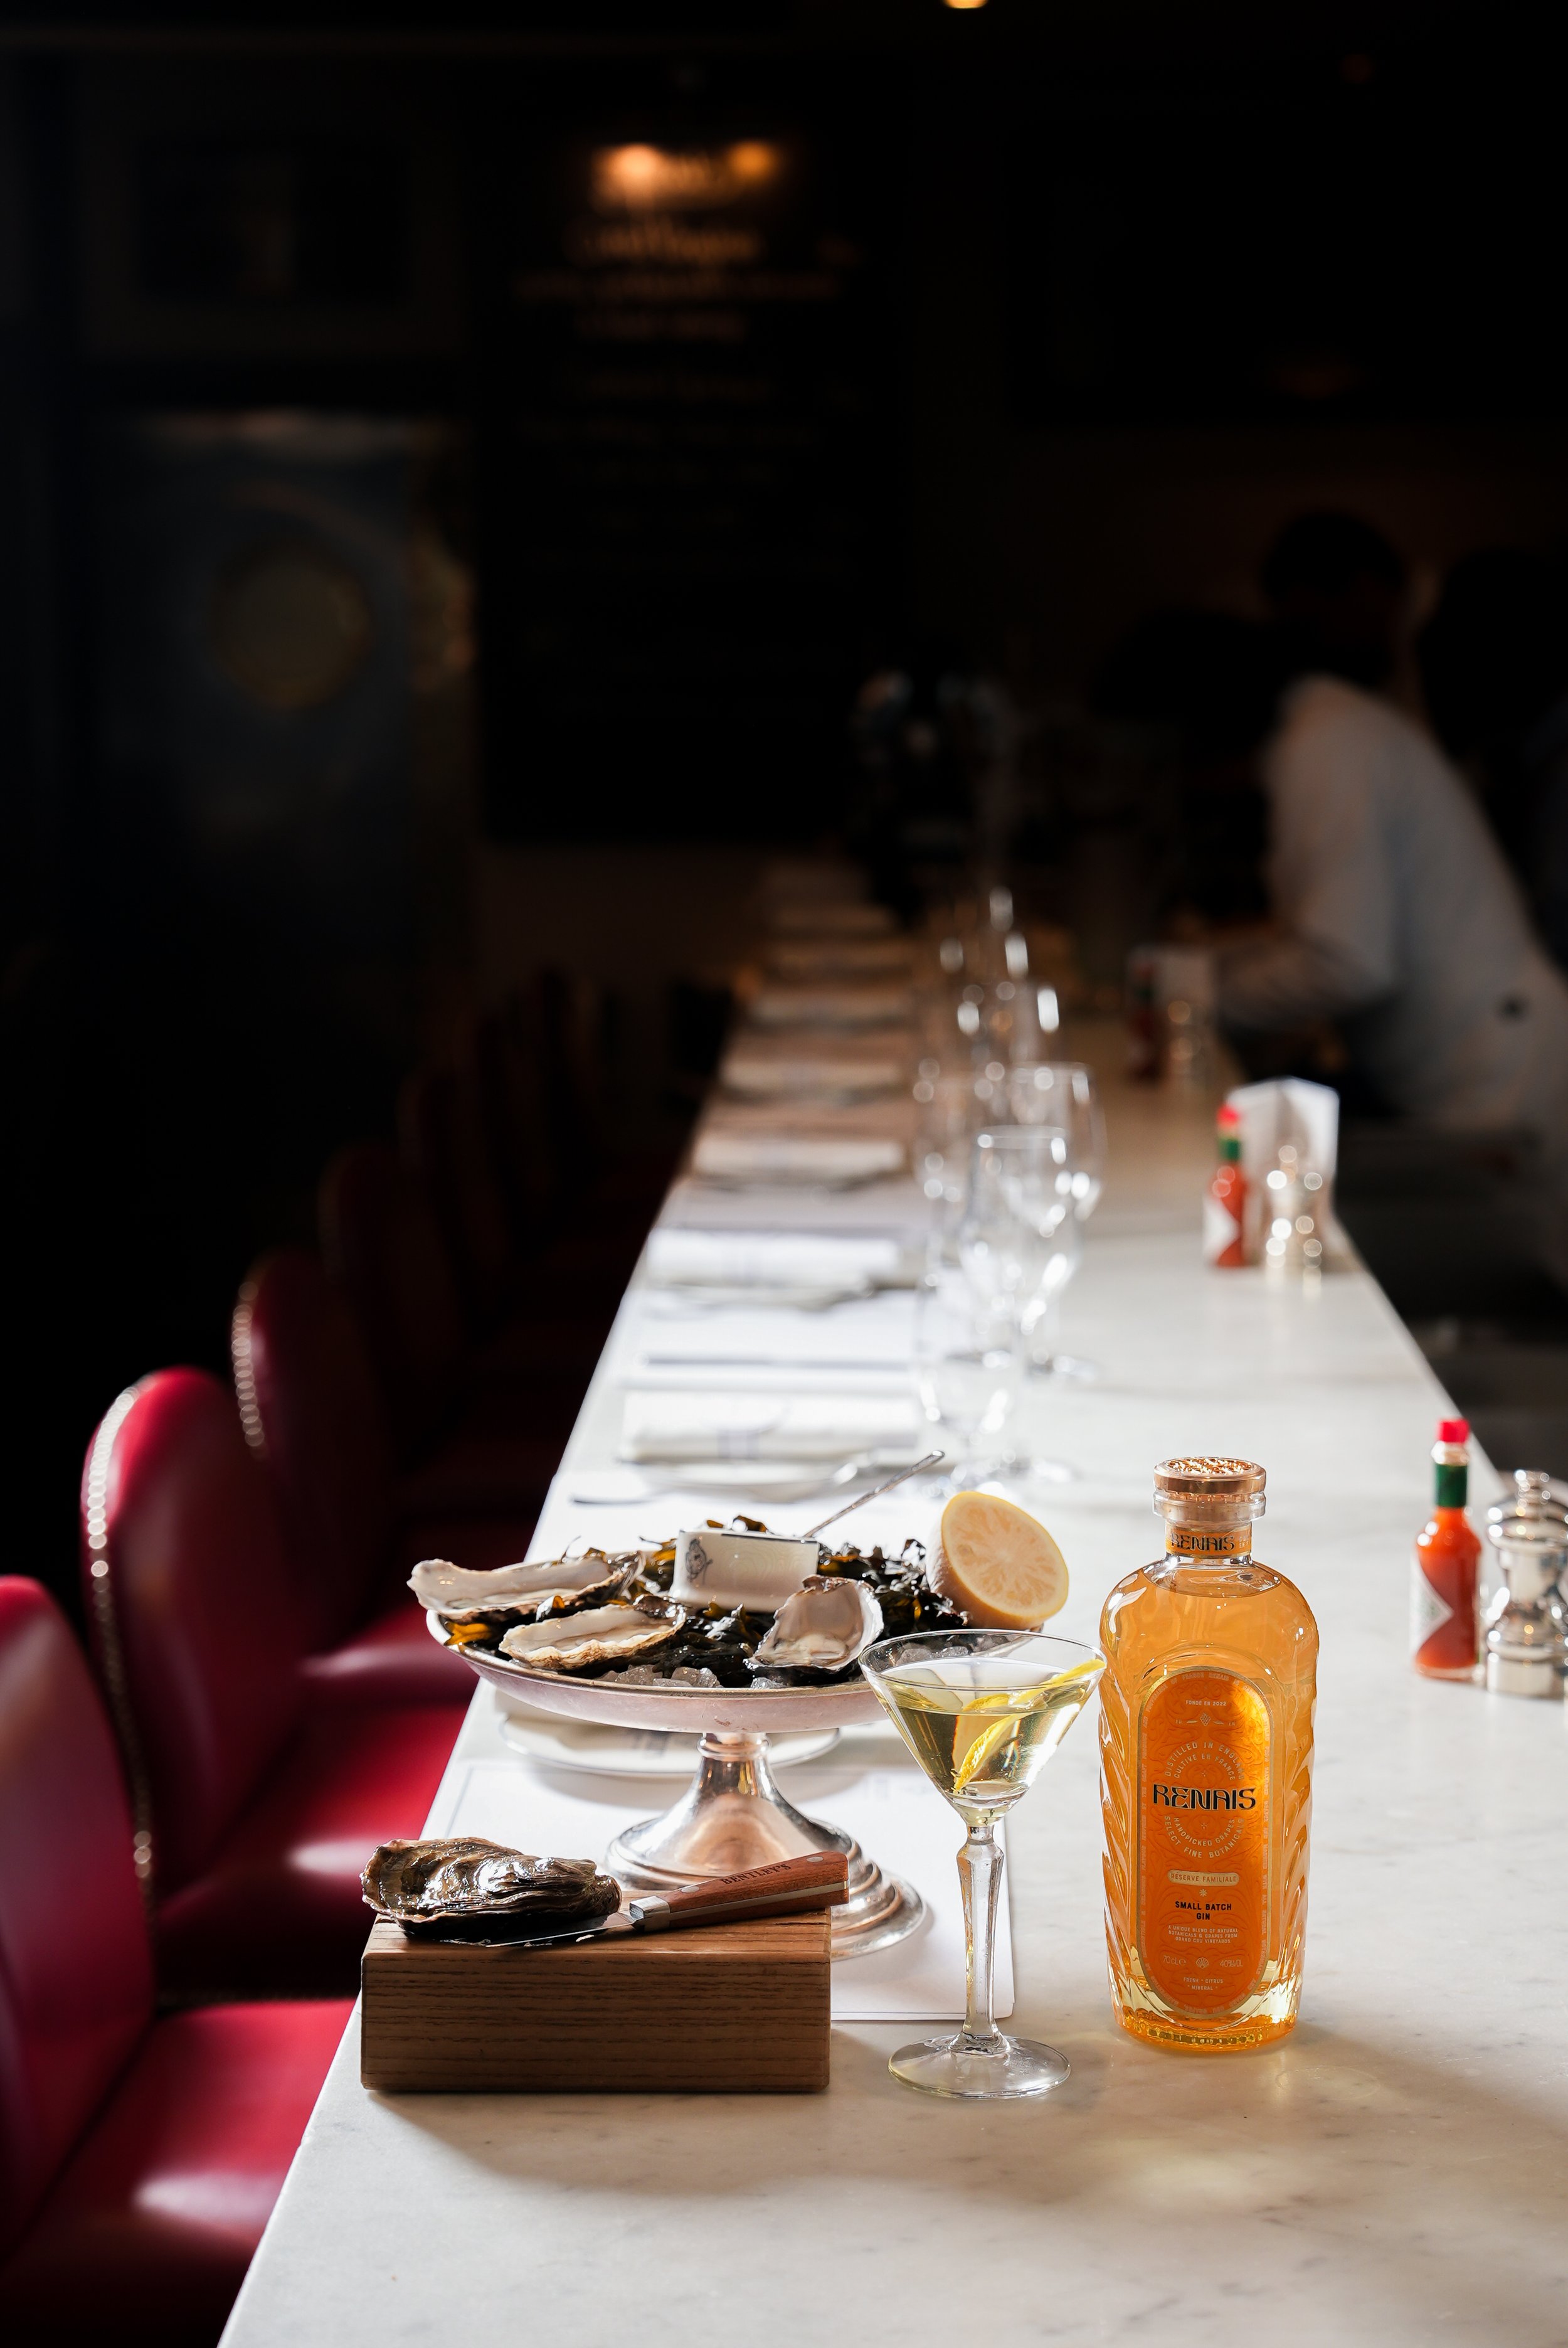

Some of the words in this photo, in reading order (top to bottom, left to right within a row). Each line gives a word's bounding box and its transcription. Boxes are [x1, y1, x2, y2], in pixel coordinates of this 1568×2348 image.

[1172, 1533, 1234, 1551] RENAIS
[1165, 1741, 1198, 1777] DISTILLED
[1219, 1745, 1244, 1780] ENGLAND
[1215, 1756, 1236, 1780] FRANCE
[1153, 1783, 1256, 1811] RENAIS
[1165, 1815, 1182, 1846] SELECT
[1184, 1847, 1202, 1858] FINE
[1209, 1818, 1244, 1858] BOTANICALS
[1173, 1817, 1212, 1847] HANDPICKED
[1216, 1819, 1235, 1844] GRAPES
[721, 1864, 792, 1884] BENTLEY'S
[1171, 1872, 1199, 1882] RÉSERVE
[1175, 1901, 1202, 1910] SMALL
